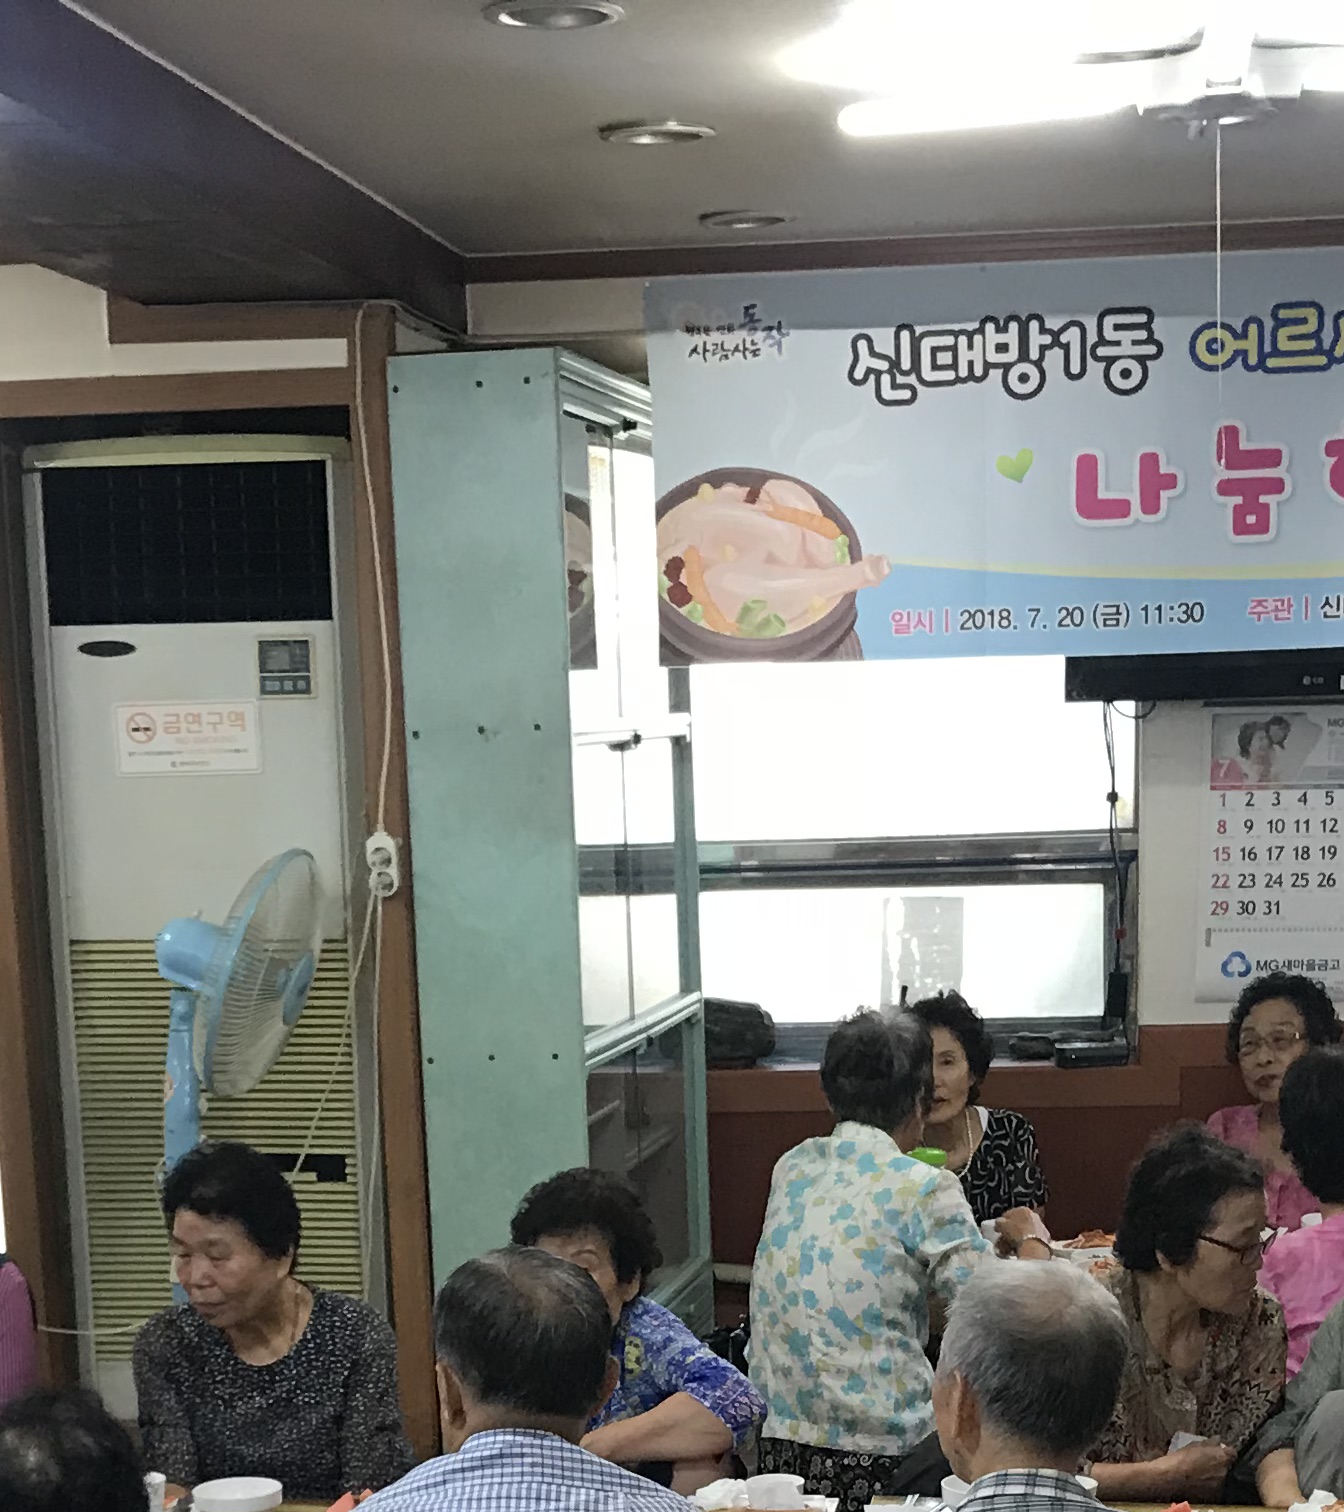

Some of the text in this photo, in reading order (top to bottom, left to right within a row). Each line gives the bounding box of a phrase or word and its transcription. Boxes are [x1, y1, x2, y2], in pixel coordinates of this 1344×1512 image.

[848, 305, 1163, 406] 신대방1동
[1248, 597, 1293, 622] 주관
[890, 609, 934, 635] 일시
[1140, 602, 1205, 625] 11:30
[163, 711, 247, 735] 금연구역
[1218, 759, 1231, 777] 7
[1220, 793, 1226, 807] 1
[1245, 792, 1255, 807] 2
[1271, 791, 1280, 807] 3
[1297, 791, 1308, 805] 4
[1325, 791, 1334, 805] 5
[1217, 819, 1227, 834] 8
[1244, 819, 1253, 834] 9
[1267, 819, 1285, 834] 10
[1294, 819, 1310, 833] 11
[1320, 818, 1338, 833] 12
[1213, 847, 1231, 862] 15
[1240, 846, 1257, 861] 16
[1266, 846, 1285, 861] 17
[1293, 846, 1310, 860] 18
[1319, 845, 1337, 860] 19
[1211, 874, 1230, 889] 22
[1238, 873, 1256, 889] 23
[1264, 873, 1283, 888] 24
[1291, 873, 1309, 888] 25
[1317, 873, 1336, 888] 26
[1210, 900, 1280, 915] 29 30 31
